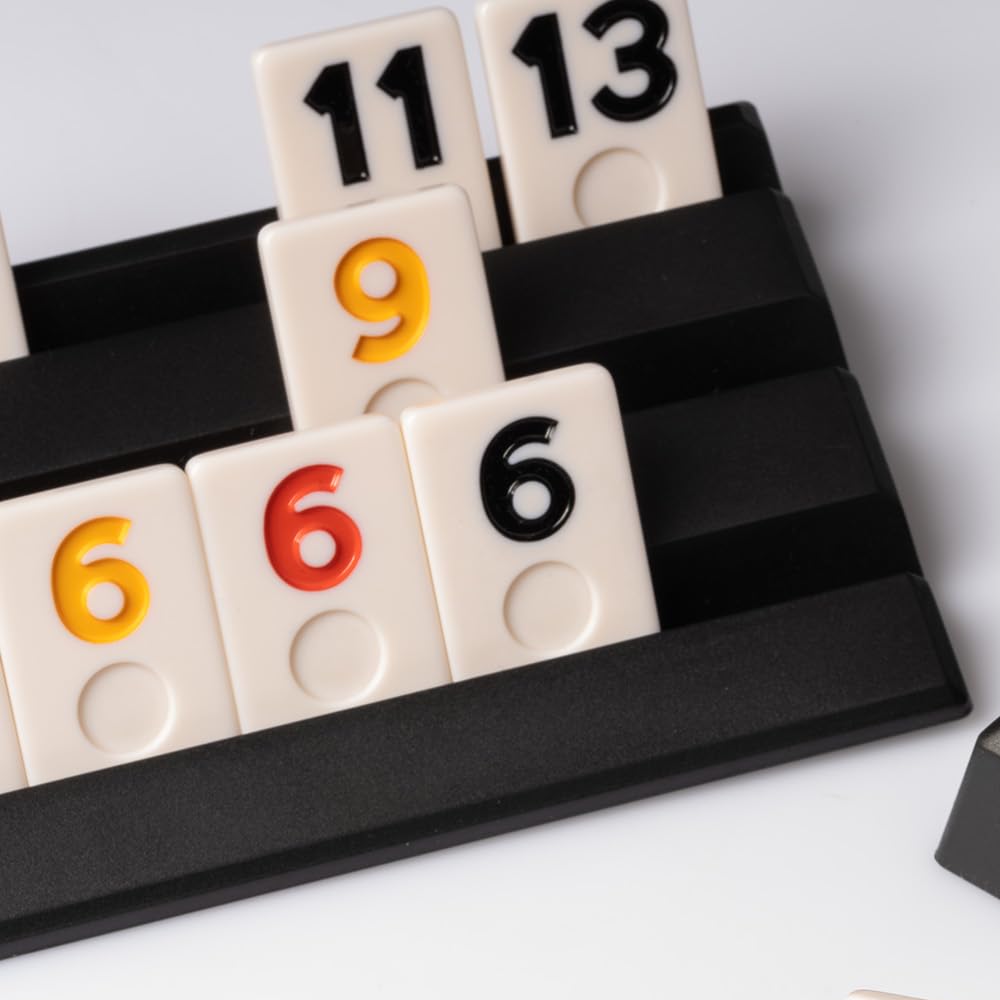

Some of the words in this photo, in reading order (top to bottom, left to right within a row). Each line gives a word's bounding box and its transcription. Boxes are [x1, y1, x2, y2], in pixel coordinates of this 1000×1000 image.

[304, 46, 442, 186] 11
[512, 0, 678, 139] 13
[332, 236, 431, 365] 9
[263, 464, 363, 592] 6
[480, 416, 575, 542] 6
[50, 515, 151, 645] 6
